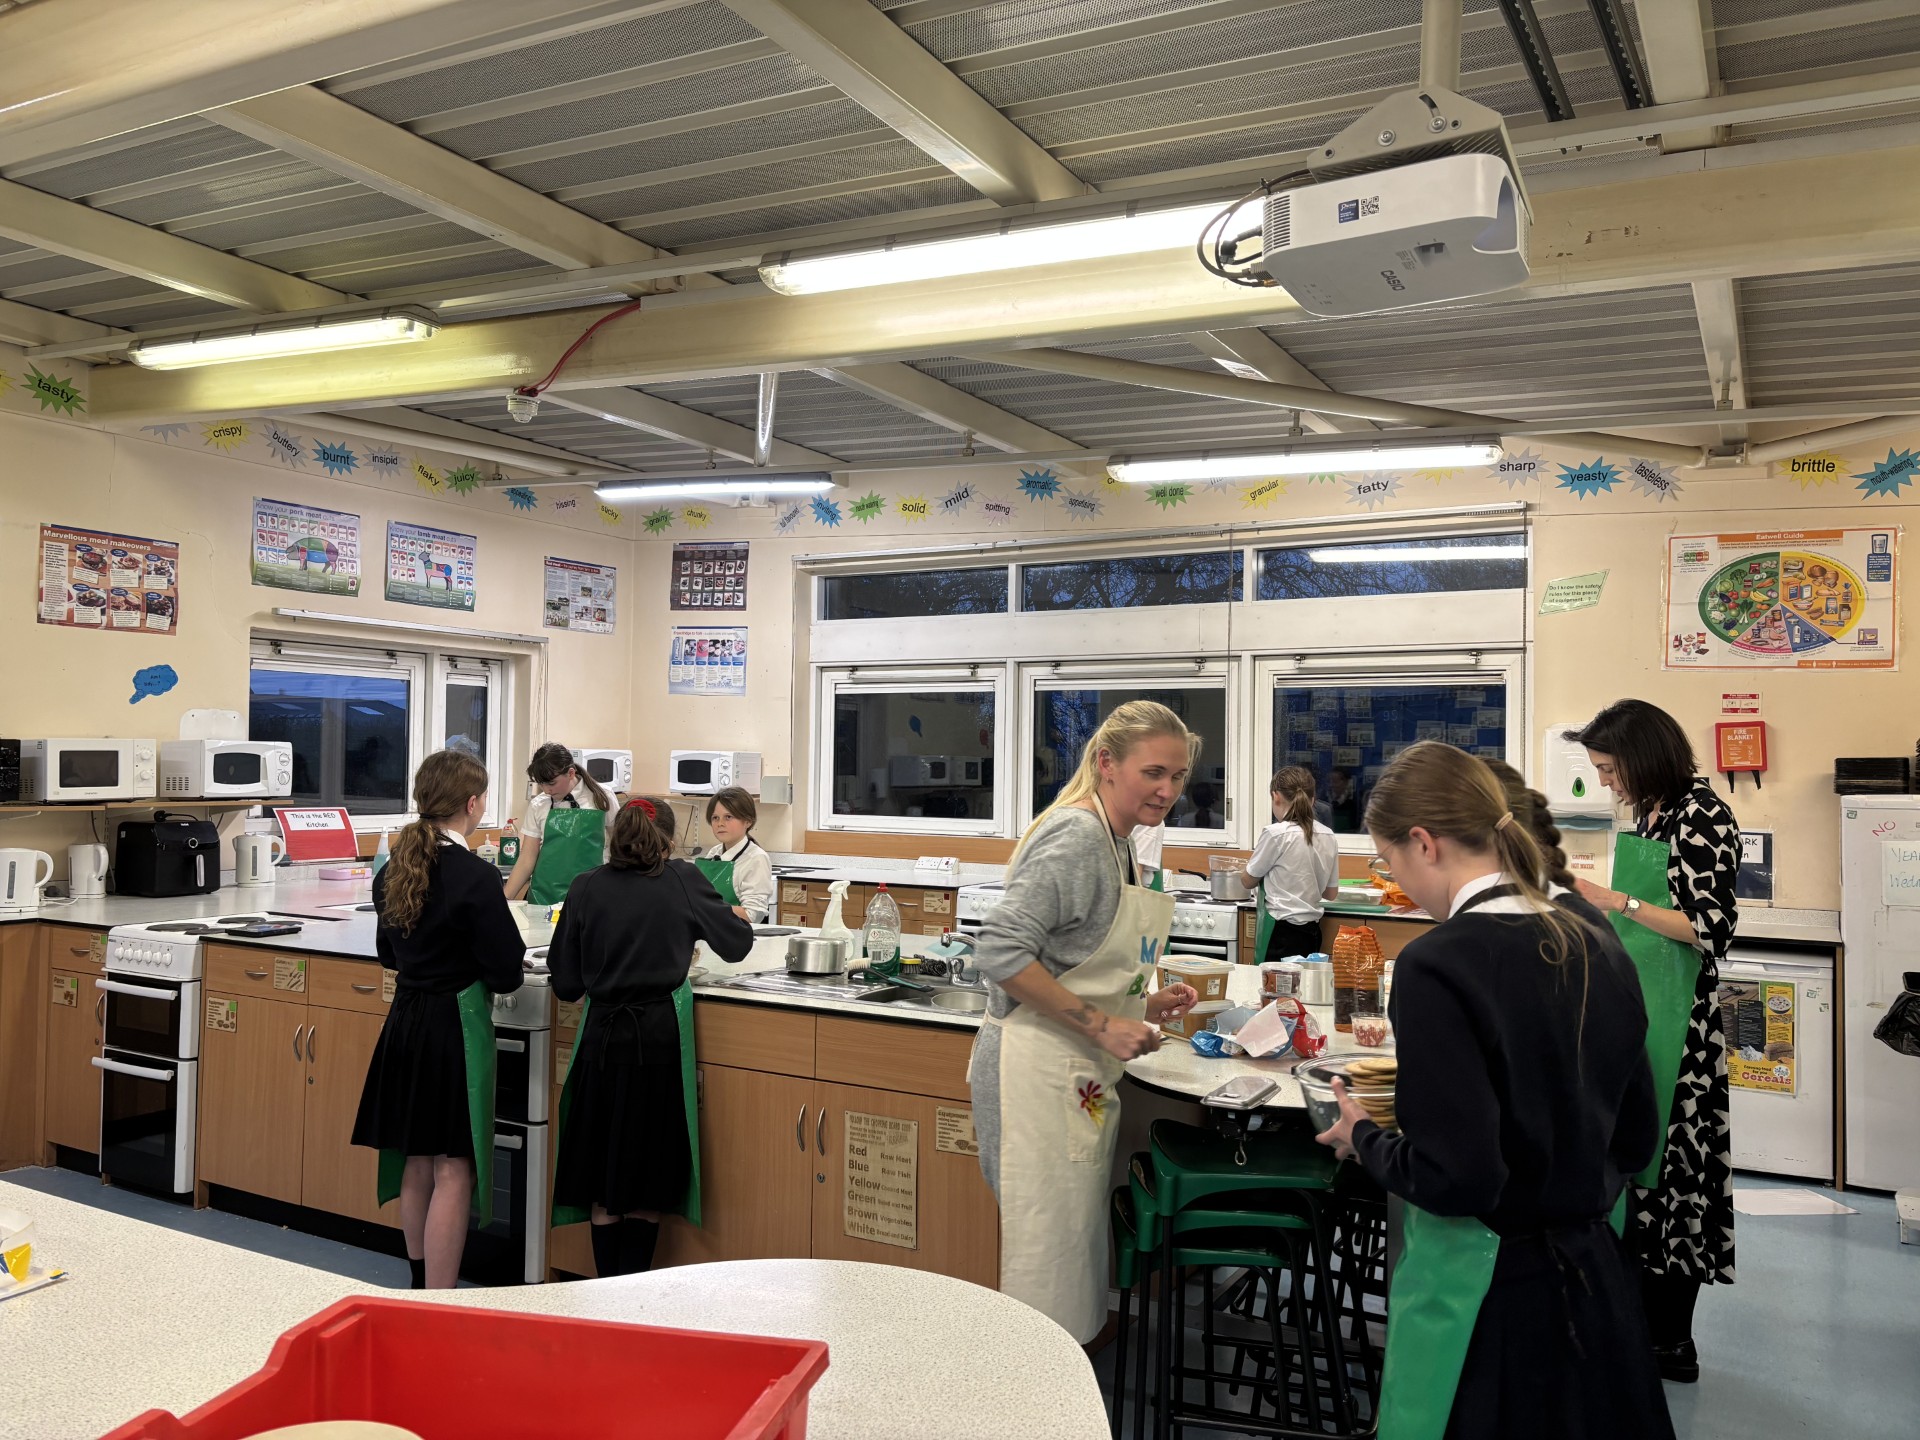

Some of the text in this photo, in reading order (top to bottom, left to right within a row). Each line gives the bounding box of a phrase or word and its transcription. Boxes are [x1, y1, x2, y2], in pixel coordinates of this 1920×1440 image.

[1381, 270, 1406, 291] CASIO
[37, 378, 74, 403] tasty
[212, 425, 242, 438] crispy
[272, 430, 300, 456] buttery
[322, 449, 350, 466] burnt
[372, 454, 398, 466] insipid
[1500, 462, 1536, 472] sharp
[1791, 458, 1836, 472] brittle
[418, 465, 440, 486] flaky
[454, 472, 475, 485] juicy
[1570, 470, 1608, 484] yeasty
[1634, 462, 1670, 491] tasteless
[1870, 458, 1915, 487] mouth-watering
[1026, 480, 1052, 490] aromatic
[1155, 486, 1184, 498] well done
[1250, 479, 1280, 501] granular
[1357, 480, 1390, 494] fatty
[945, 488, 969, 508] mild
[816, 501, 836, 520] inviting
[902, 502, 926, 514] solid
[984, 502, 1011, 516] spitting
[648, 514, 668, 527] grainy
[686, 509, 707, 522] chunky
[43, 529, 152, 552] Marvellous meal makeovers
[1891, 848, 1920, 862] YEA
[1742, 1072, 1791, 1084] Cereals
[889, 1121, 900, 1130] BOARD
[849, 1144, 867, 1156] Red
[896, 1155, 911, 1164] Meat
[849, 1160, 869, 1172] Blue
[898, 1170, 911, 1178] Fish
[849, 1176, 880, 1190] Yellow
[848, 1190, 876, 1204] Green
[848, 1206, 912, 1226] Brown Vegetables
[848, 1221, 875, 1235] White
[901, 1234, 914, 1243] Dairy
